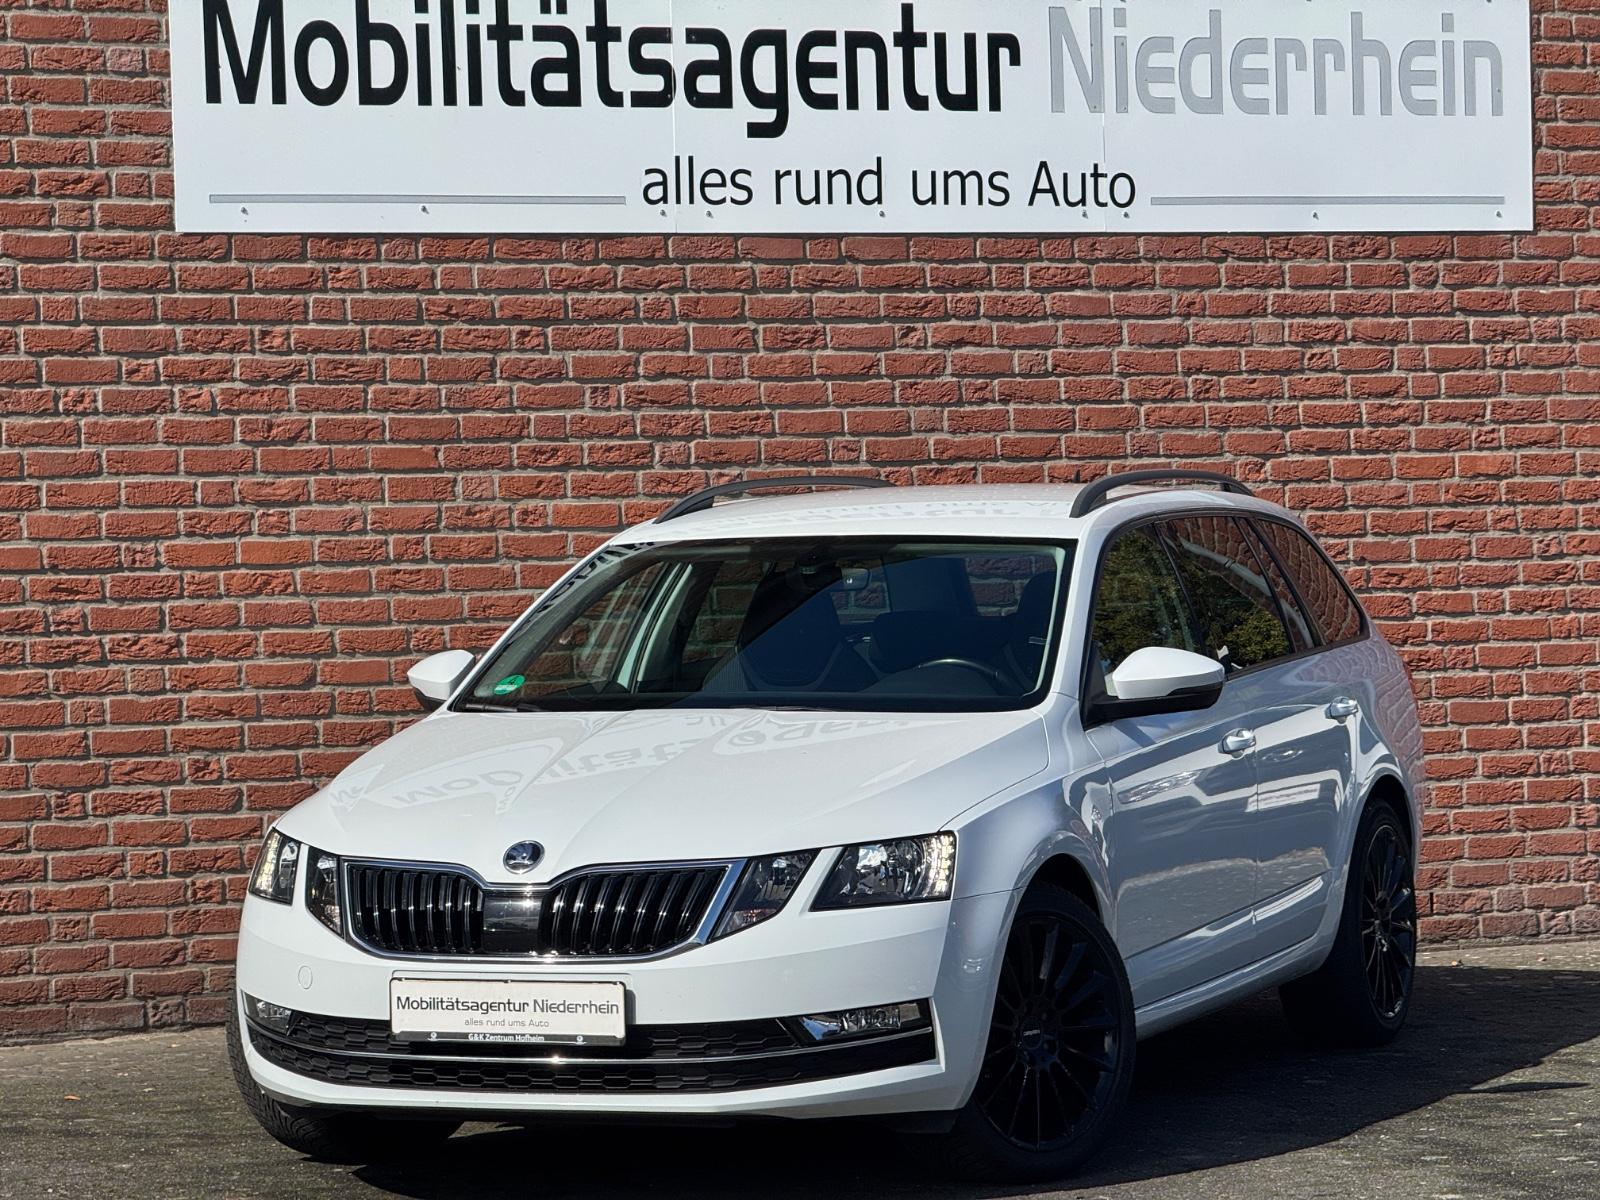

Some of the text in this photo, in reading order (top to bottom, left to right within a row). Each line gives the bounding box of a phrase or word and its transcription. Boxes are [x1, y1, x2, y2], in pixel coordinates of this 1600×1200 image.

[203, 0, 1504, 138] Mobilitätsagentur Niederrhein
[643, 156, 1136, 207] alles rund ums Auto
[396, 996, 619, 1014] Mobilitätsagentur Niederrhein
[464, 1017, 484, 1026] alles
[486, 1018, 506, 1027] rund
[528, 1018, 550, 1028] Auto
